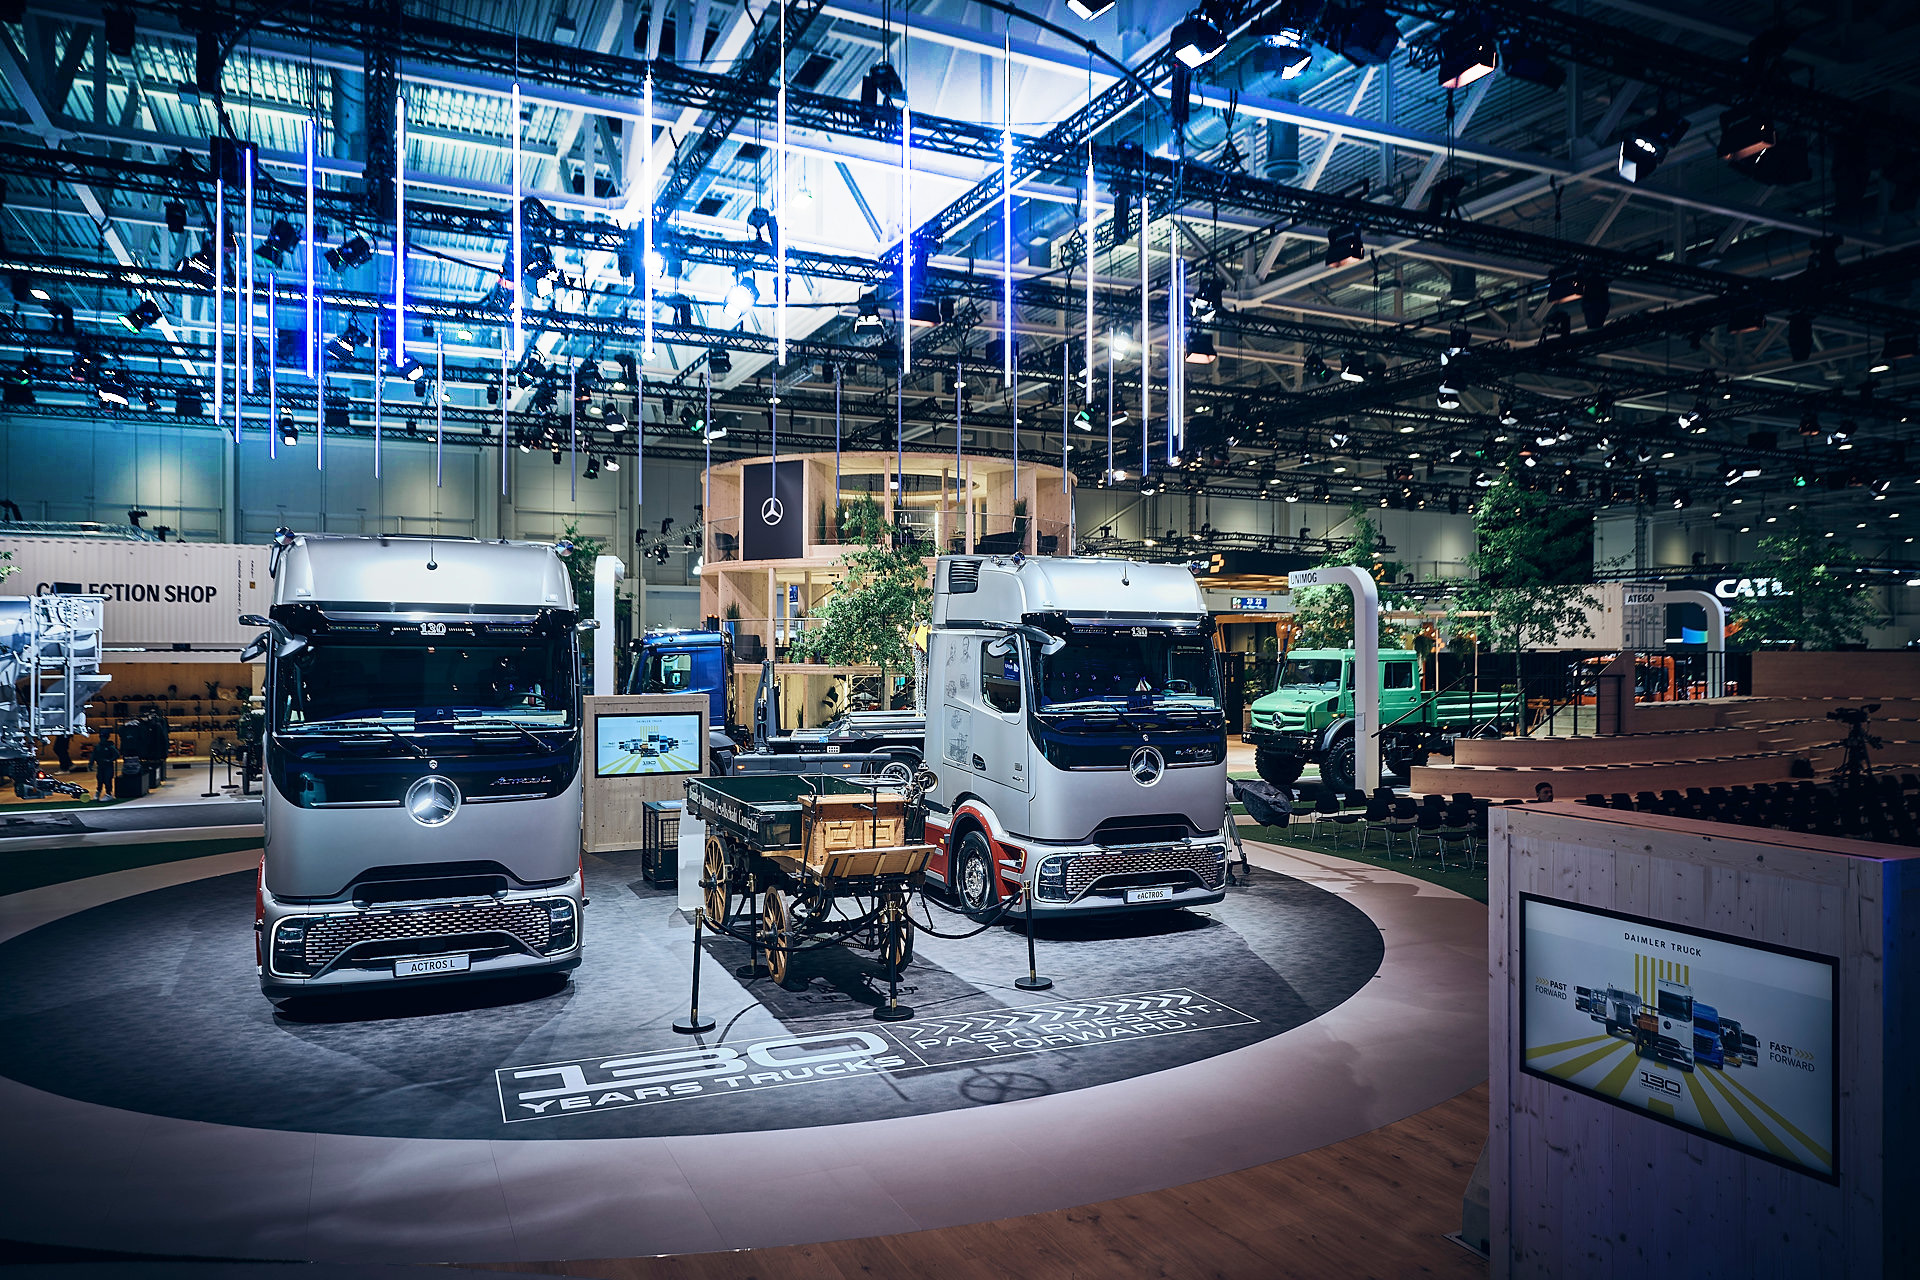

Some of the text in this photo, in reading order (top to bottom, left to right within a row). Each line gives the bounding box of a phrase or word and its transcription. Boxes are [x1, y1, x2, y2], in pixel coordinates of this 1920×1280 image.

[1290, 572, 1317, 584] UNIMOG
[36, 582, 217, 603] CECTION SHOP
[1627, 594, 1655, 603] ATEGO
[420, 623, 447, 634] 130
[1137, 891, 1164, 900] eACTROS
[1624, 932, 1702, 957] DAIMLER TRUCK
[411, 959, 455, 972] ACTROS L
[1535, 984, 1567, 1000] FORWARD
[1550, 980, 1567, 991] PAST
[916, 1004, 1223, 1050] PAST. PRESENT.
[984, 1020, 1198, 1053] FORWARD.
[1770, 1041, 1792, 1055] FAST
[514, 1031, 890, 1100] 130
[1770, 1052, 1815, 1072] FORWARD
[518, 1055, 906, 1113] YEARS TRUCKS
[1641, 1071, 1680, 1094] 130
